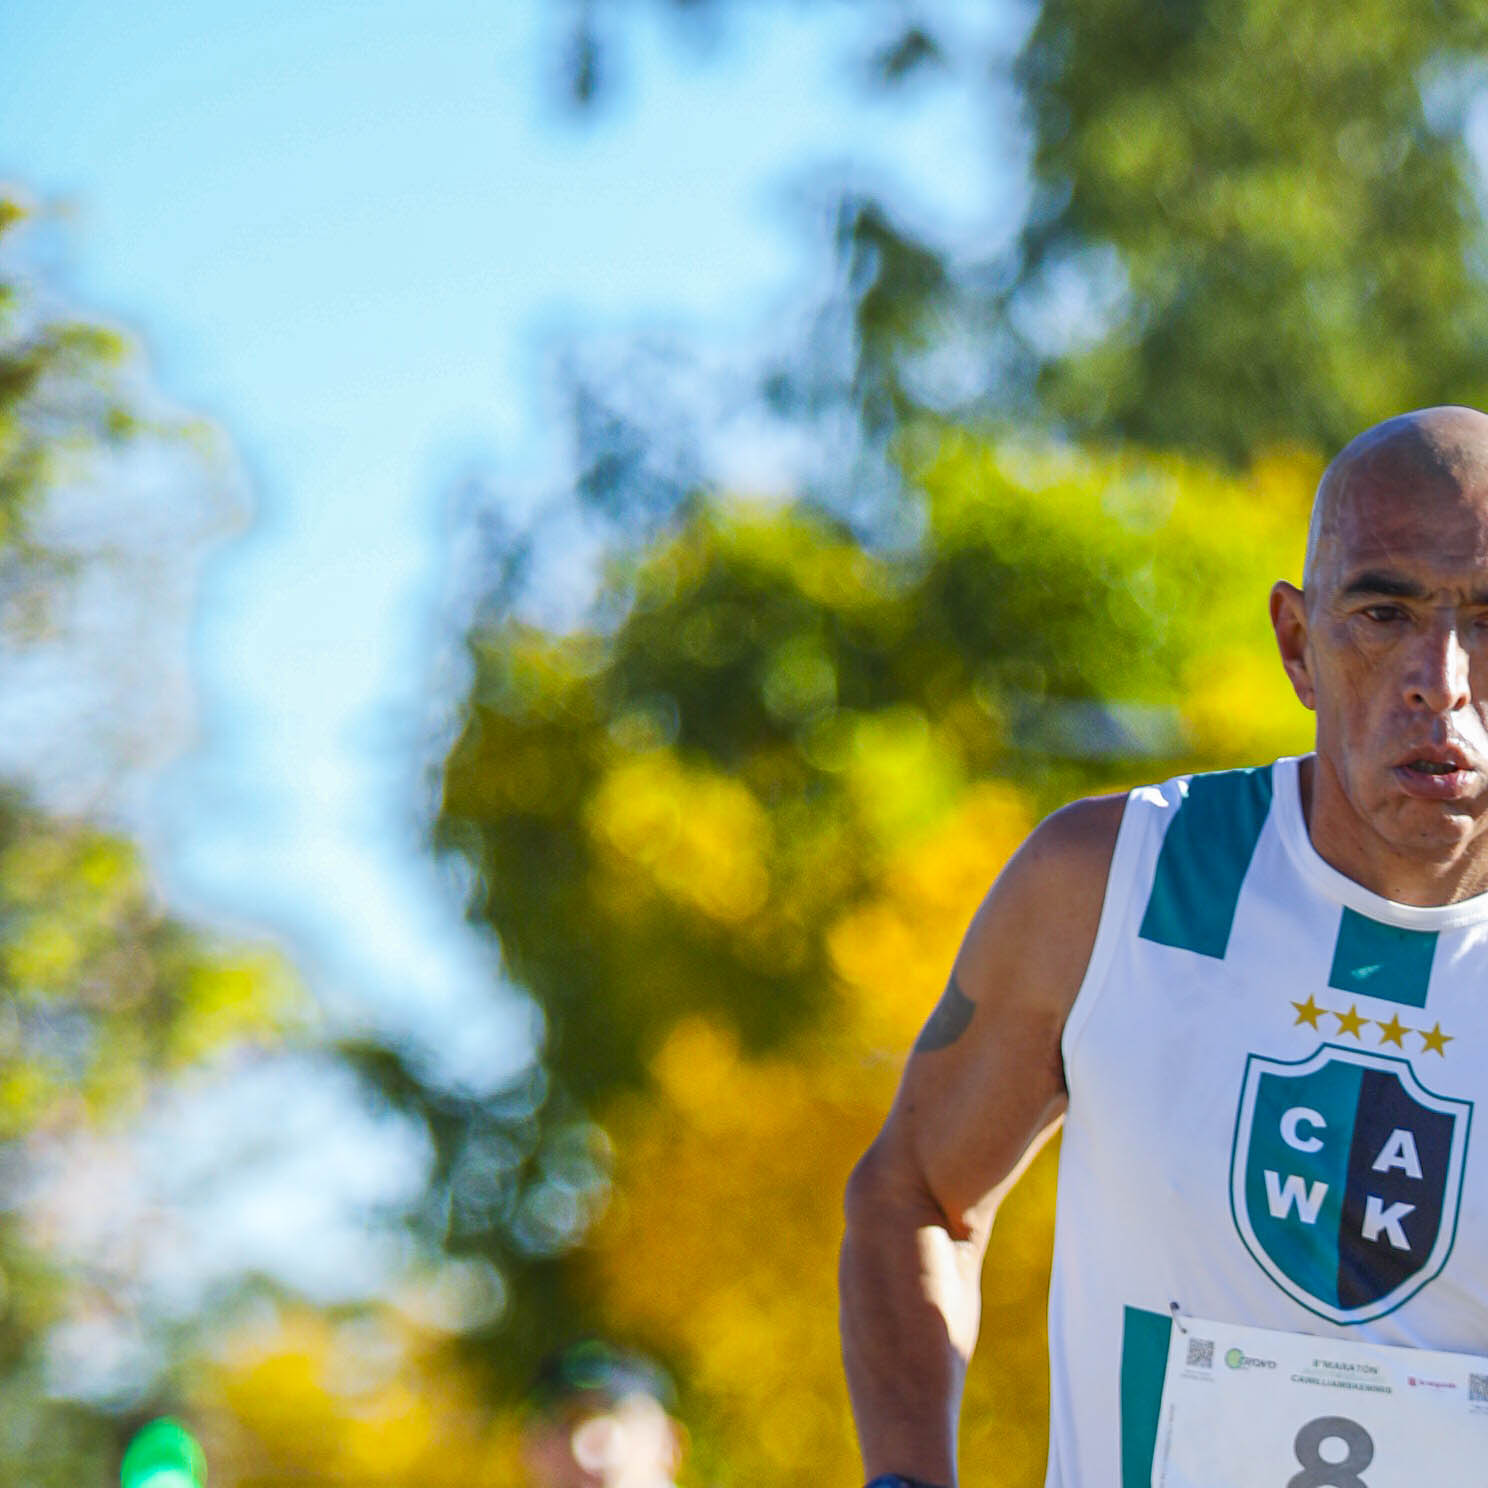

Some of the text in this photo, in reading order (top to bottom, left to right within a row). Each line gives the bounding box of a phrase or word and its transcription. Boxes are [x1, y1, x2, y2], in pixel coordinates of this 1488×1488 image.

[1279, 1106, 1424, 1180] C A
[1263, 1169, 1417, 1251] W K
